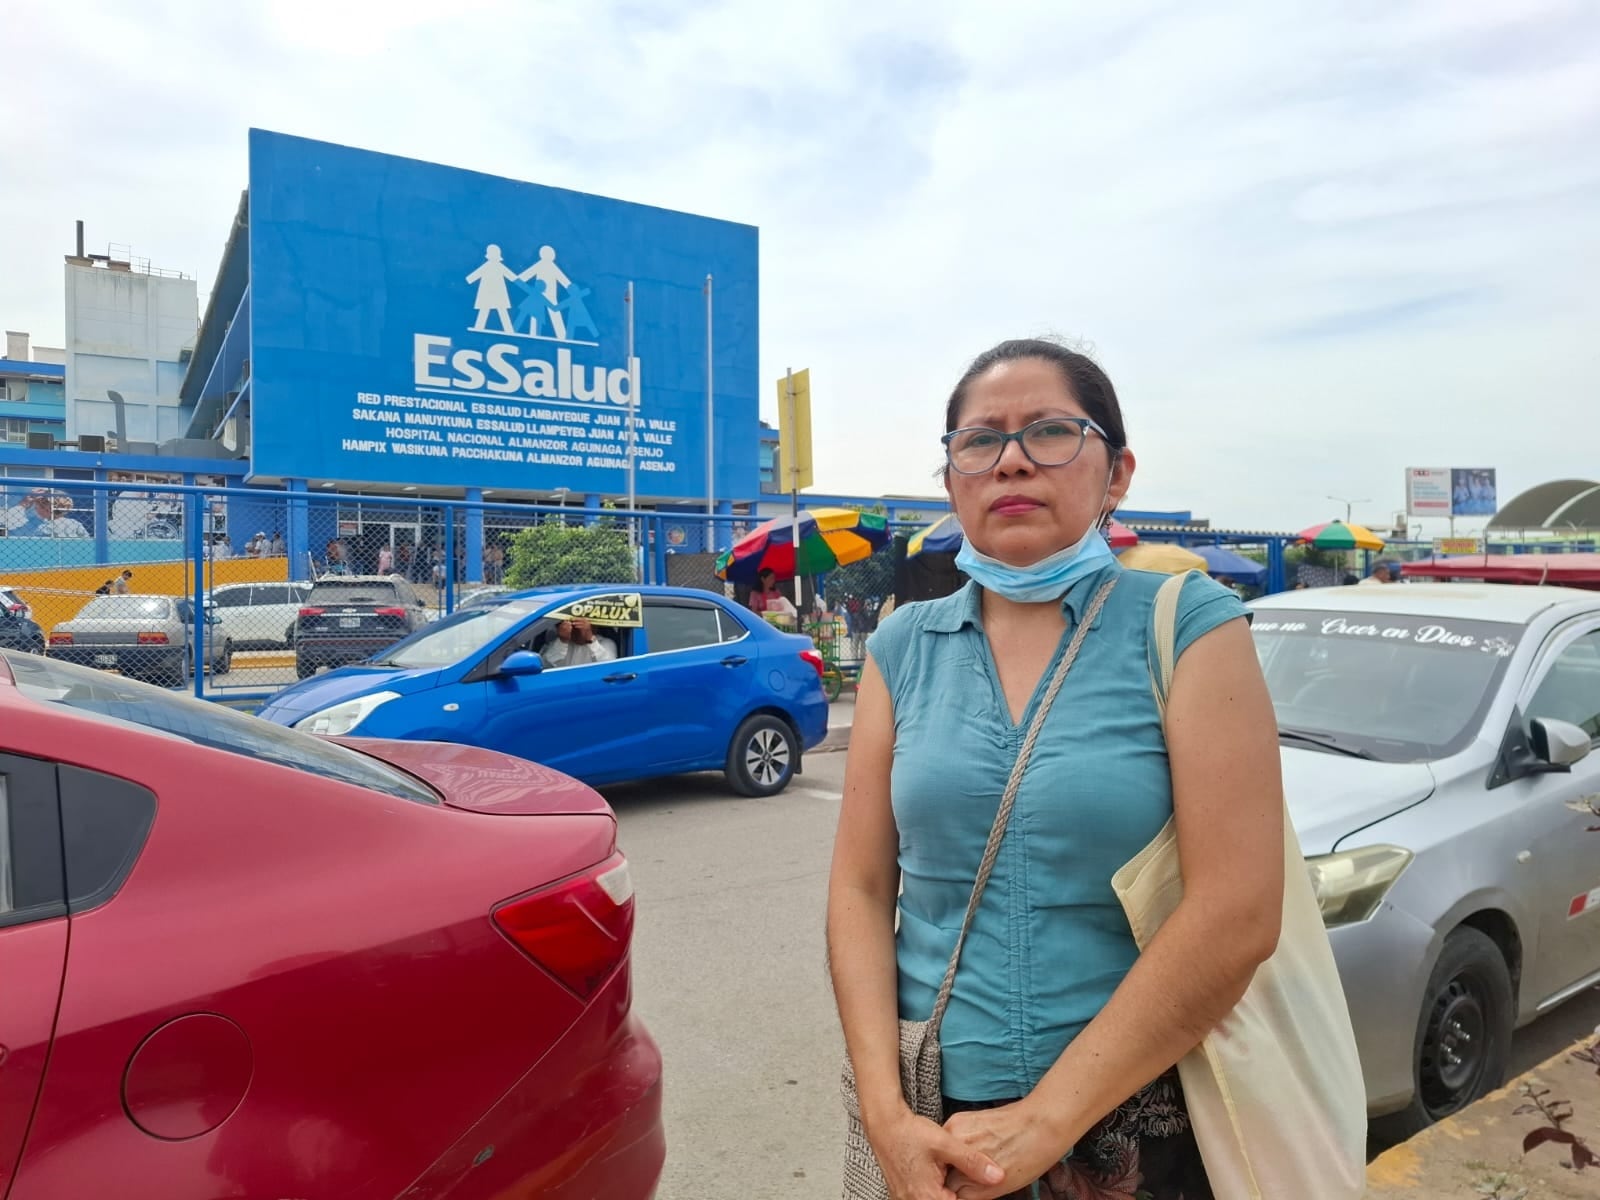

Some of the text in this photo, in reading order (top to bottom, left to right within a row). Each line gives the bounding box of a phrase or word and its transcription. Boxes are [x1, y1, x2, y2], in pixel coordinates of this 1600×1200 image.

[413, 332, 641, 406] EsSalud
[352, 408, 401, 423] SAKANA
[404, 412, 473, 429] MANUYKUNA
[476, 418, 525, 434] ESSALUD
[588, 428, 615, 440] JUAN
[643, 432, 673, 445] VALLE
[357, 392, 676, 432] RED PRESTACIONAL ESSALUD LAMBAYEQUE JUAN ATA VALLE
[342, 438, 387, 453] HAMPIX
[391, 442, 448, 457] WASIKUNA
[452, 447, 524, 463] PACCHAKUNA
[527, 452, 583, 466] ALMANZOR
[639, 461, 676, 473] ASENJO
[385, 427, 664, 458] HOSPITAL NACIONAL ALMANZOR AGUINAGA ASENJO
[571, 604, 631, 620] OPALUX
[1320, 618, 1379, 636] Creer
[1414, 625, 1476, 647] Dios
